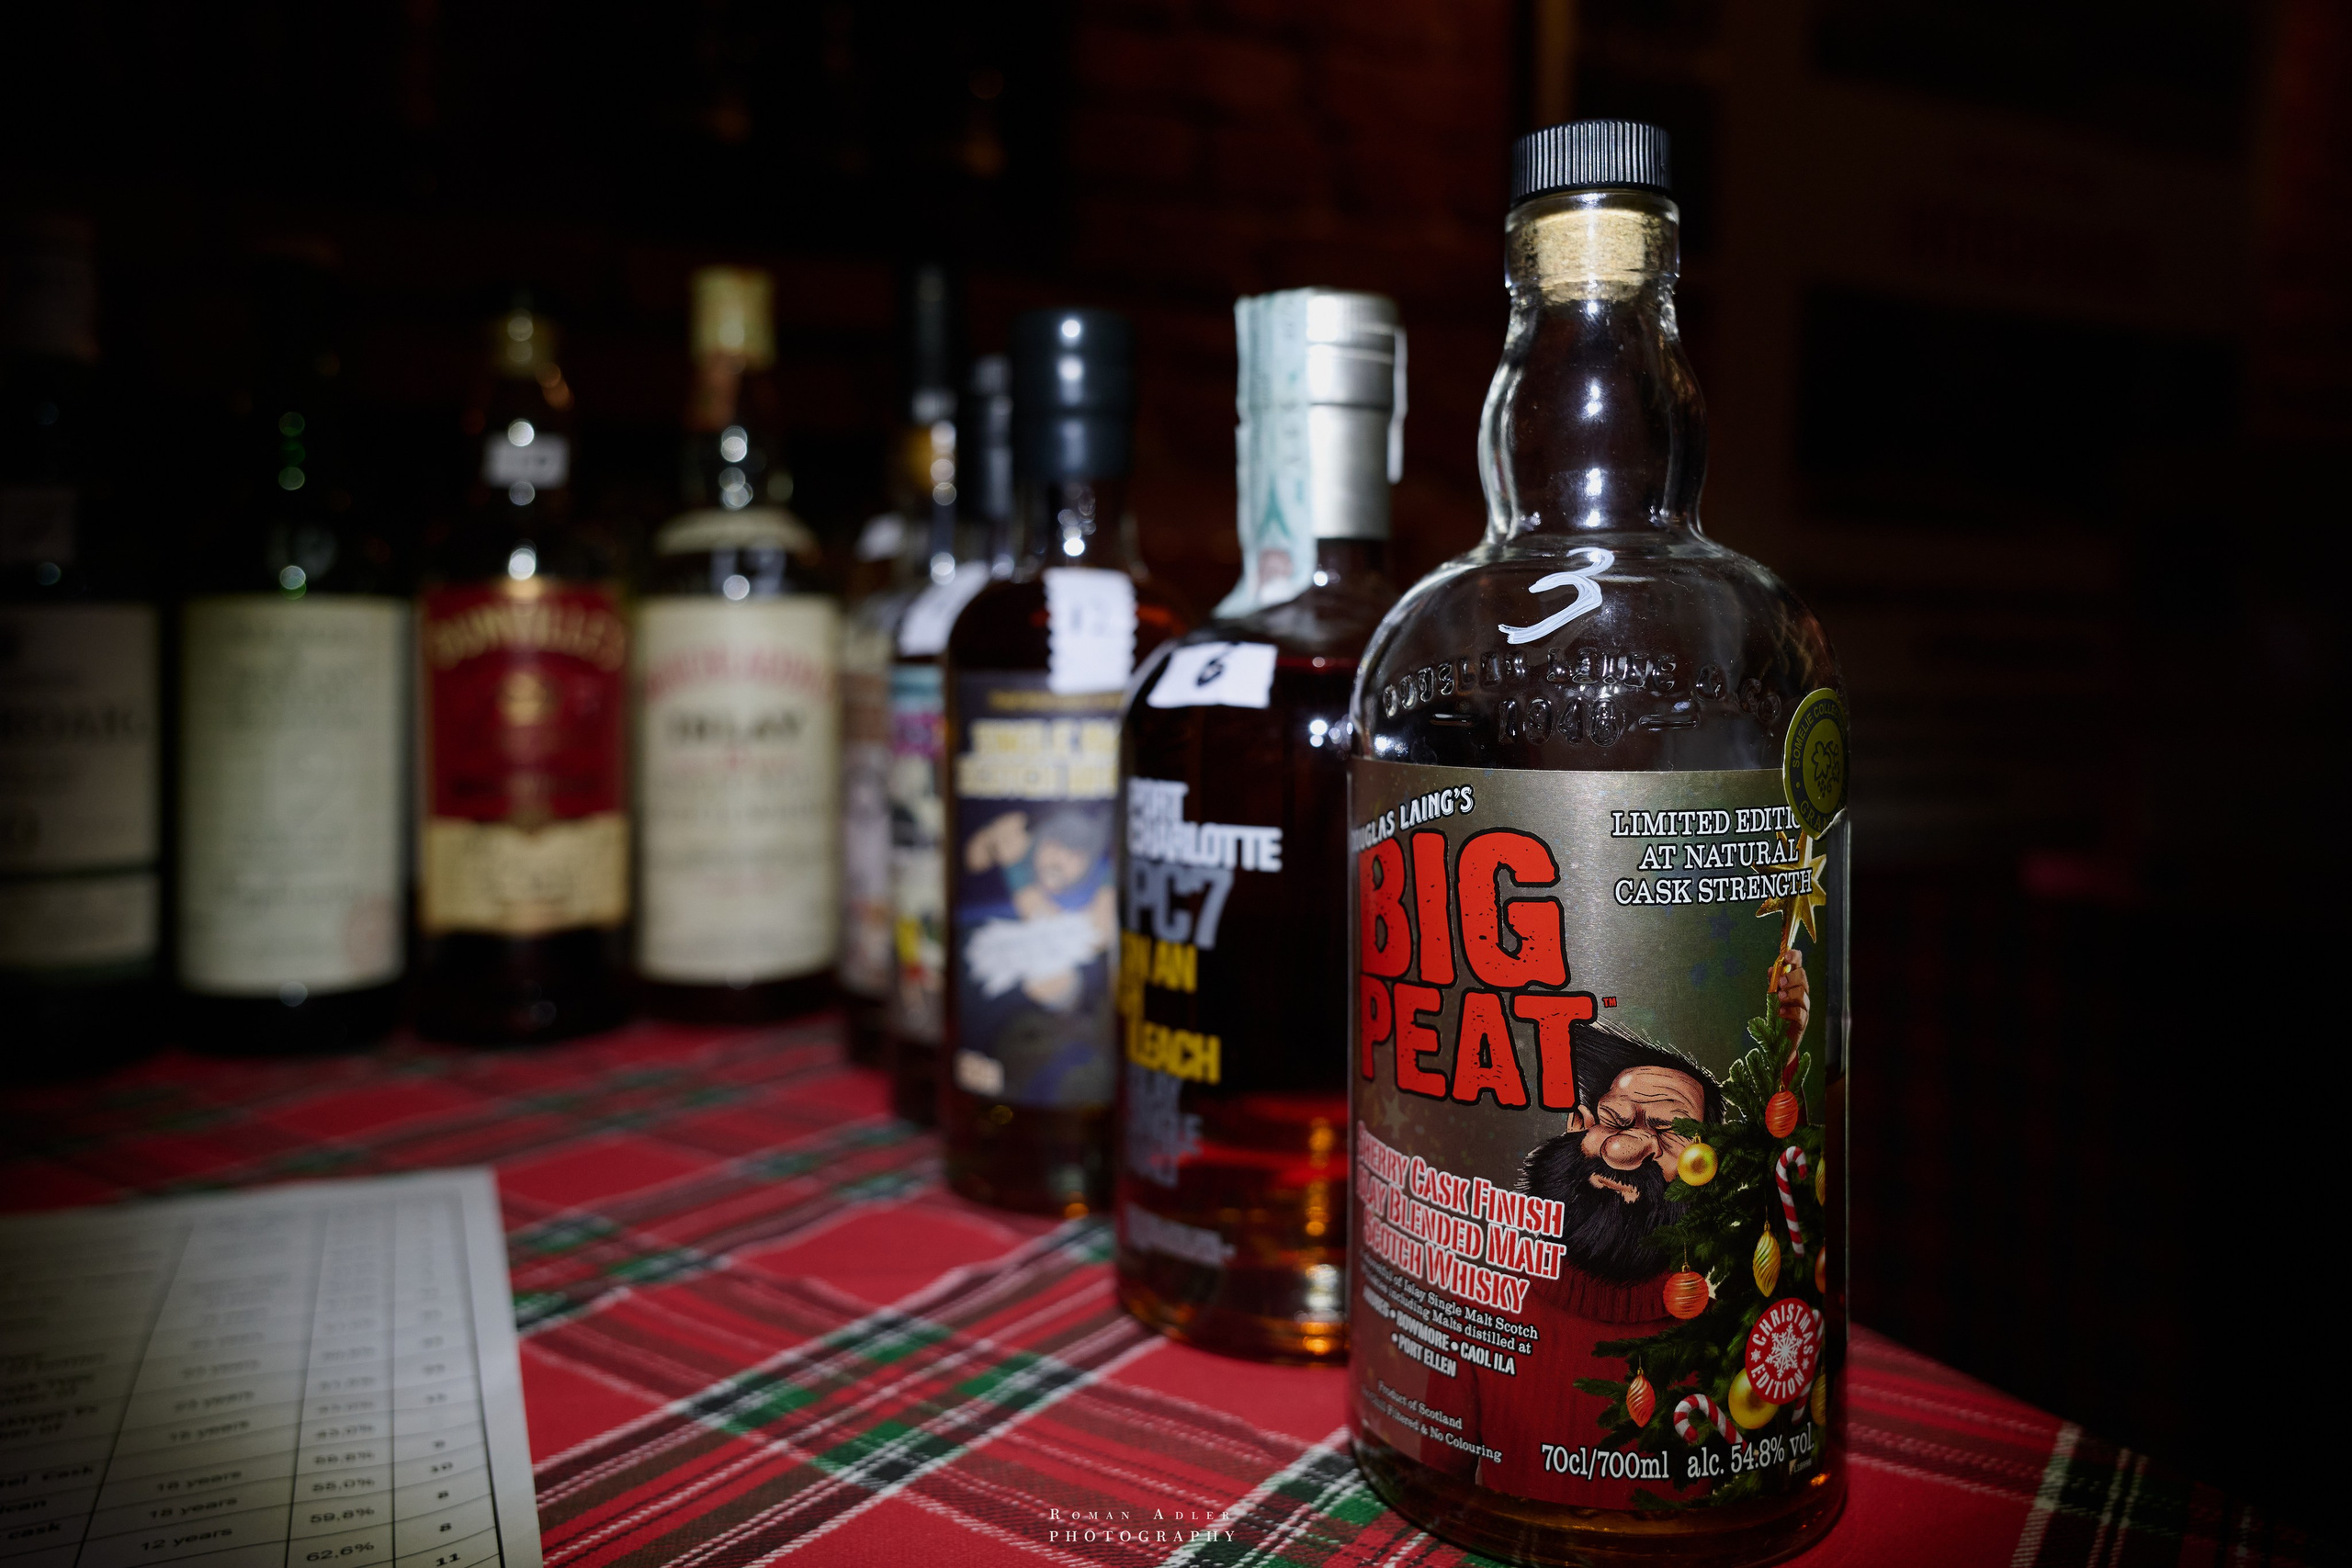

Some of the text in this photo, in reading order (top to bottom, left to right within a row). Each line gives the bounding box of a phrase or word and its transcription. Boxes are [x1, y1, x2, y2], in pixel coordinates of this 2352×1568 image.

[1498, 547, 1615, 644] 3
[1399, 785, 1475, 830] LAING'S
[1611, 810, 1731, 838] LIMITED
[1638, 837, 1799, 871] AT NATURAL
[1129, 862, 1235, 953] PC7
[1357, 829, 1569, 989] BIG
[1614, 868, 1813, 906] CASK STRENGTH
[1359, 985, 1597, 1111] PEAT
[1409, 1156, 1471, 1215] CASK
[1471, 1177, 1565, 1237] FINISH
[1387, 1183, 1485, 1259] BLENDED
[1486, 1223, 1566, 1280] MALT
[1425, 1242, 1530, 1314] WHISKY
[1388, 1286, 1430, 1321] including
[1432, 1311, 1463, 1332] Malts
[1464, 1319, 1515, 1350] distilled
[1519, 1341, 1532, 1354] at
[1404, 1279, 1426, 1303] Islay
[1427, 1292, 1463, 1316] Single
[1464, 1306, 1493, 1326] Malt
[1495, 1316, 1538, 1339] Scotch
[1752, 1303, 1814, 1355] CHRISTMAS
[1396, 1309, 1516, 1375] BOWMORE CAOL ILA
[1397, 1333, 1457, 1377] PORT ELLEN
[1750, 1362, 1805, 1399] EDITION
[1419, 1403, 1463, 1430] Scotland
[1430, 1425, 1444, 1441] No
[1445, 1431, 1503, 1463] Colouring
[1541, 1444, 1669, 1481] 70cl/700ml
[1687, 1447, 1724, 1478] alc.
[1730, 1434, 1785, 1472] 54.8%
[172, 1527, 233, 1548] years
